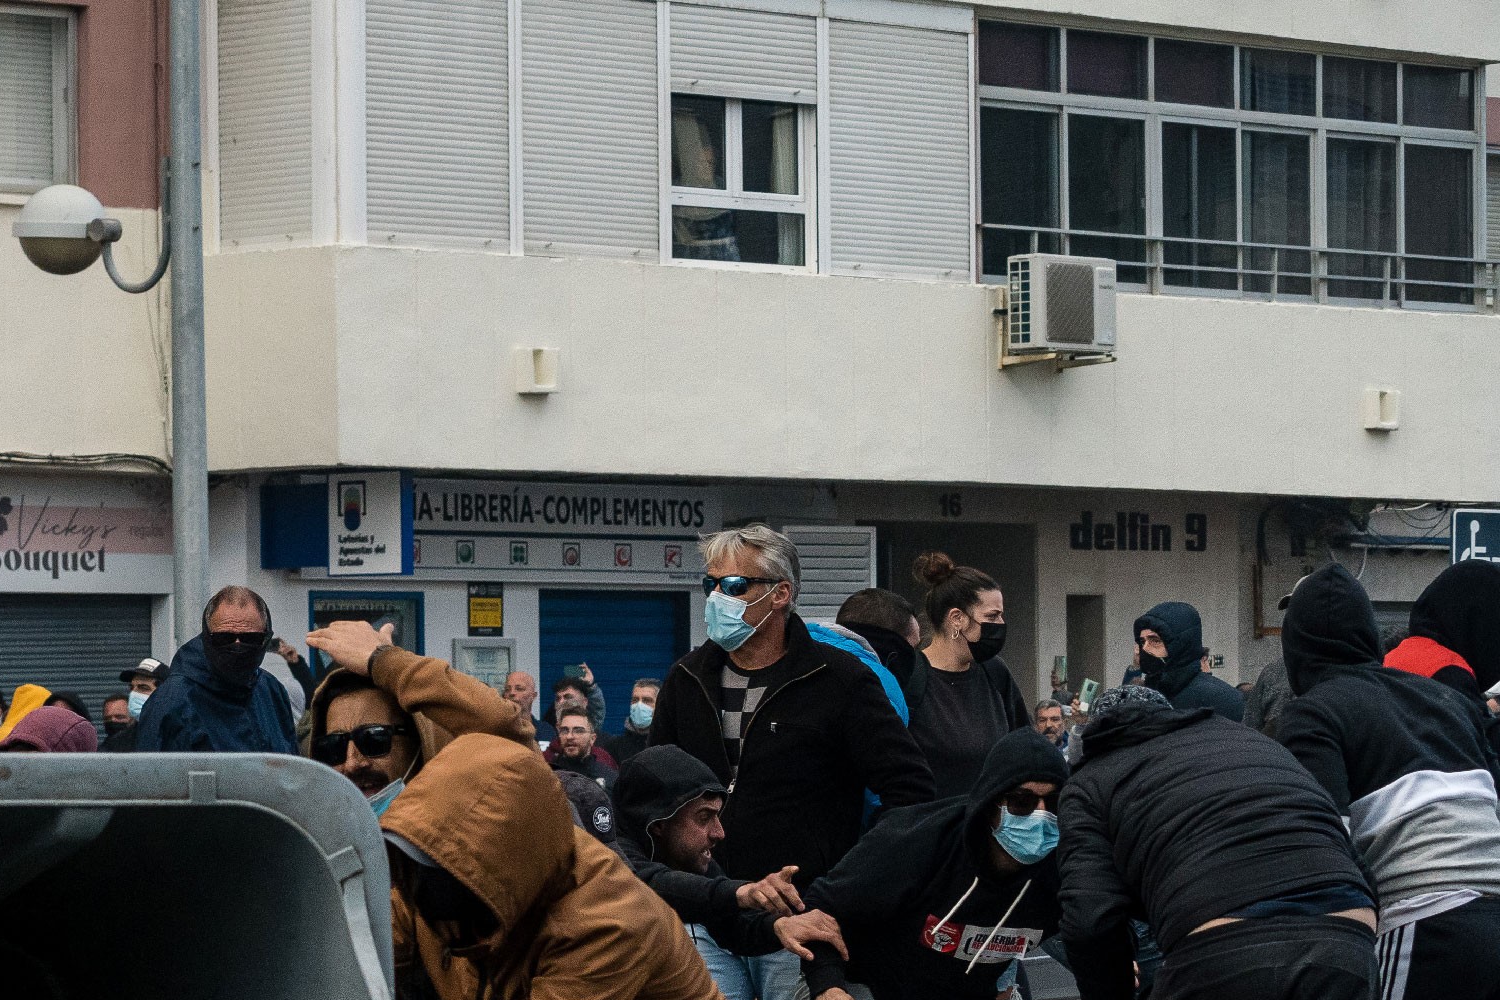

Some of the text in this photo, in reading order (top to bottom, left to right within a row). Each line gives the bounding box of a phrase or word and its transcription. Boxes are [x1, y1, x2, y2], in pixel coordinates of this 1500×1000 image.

[17, 494, 117, 549] Vicky's
[940, 493, 963, 518] 16
[1185, 513, 1208, 552] 9
